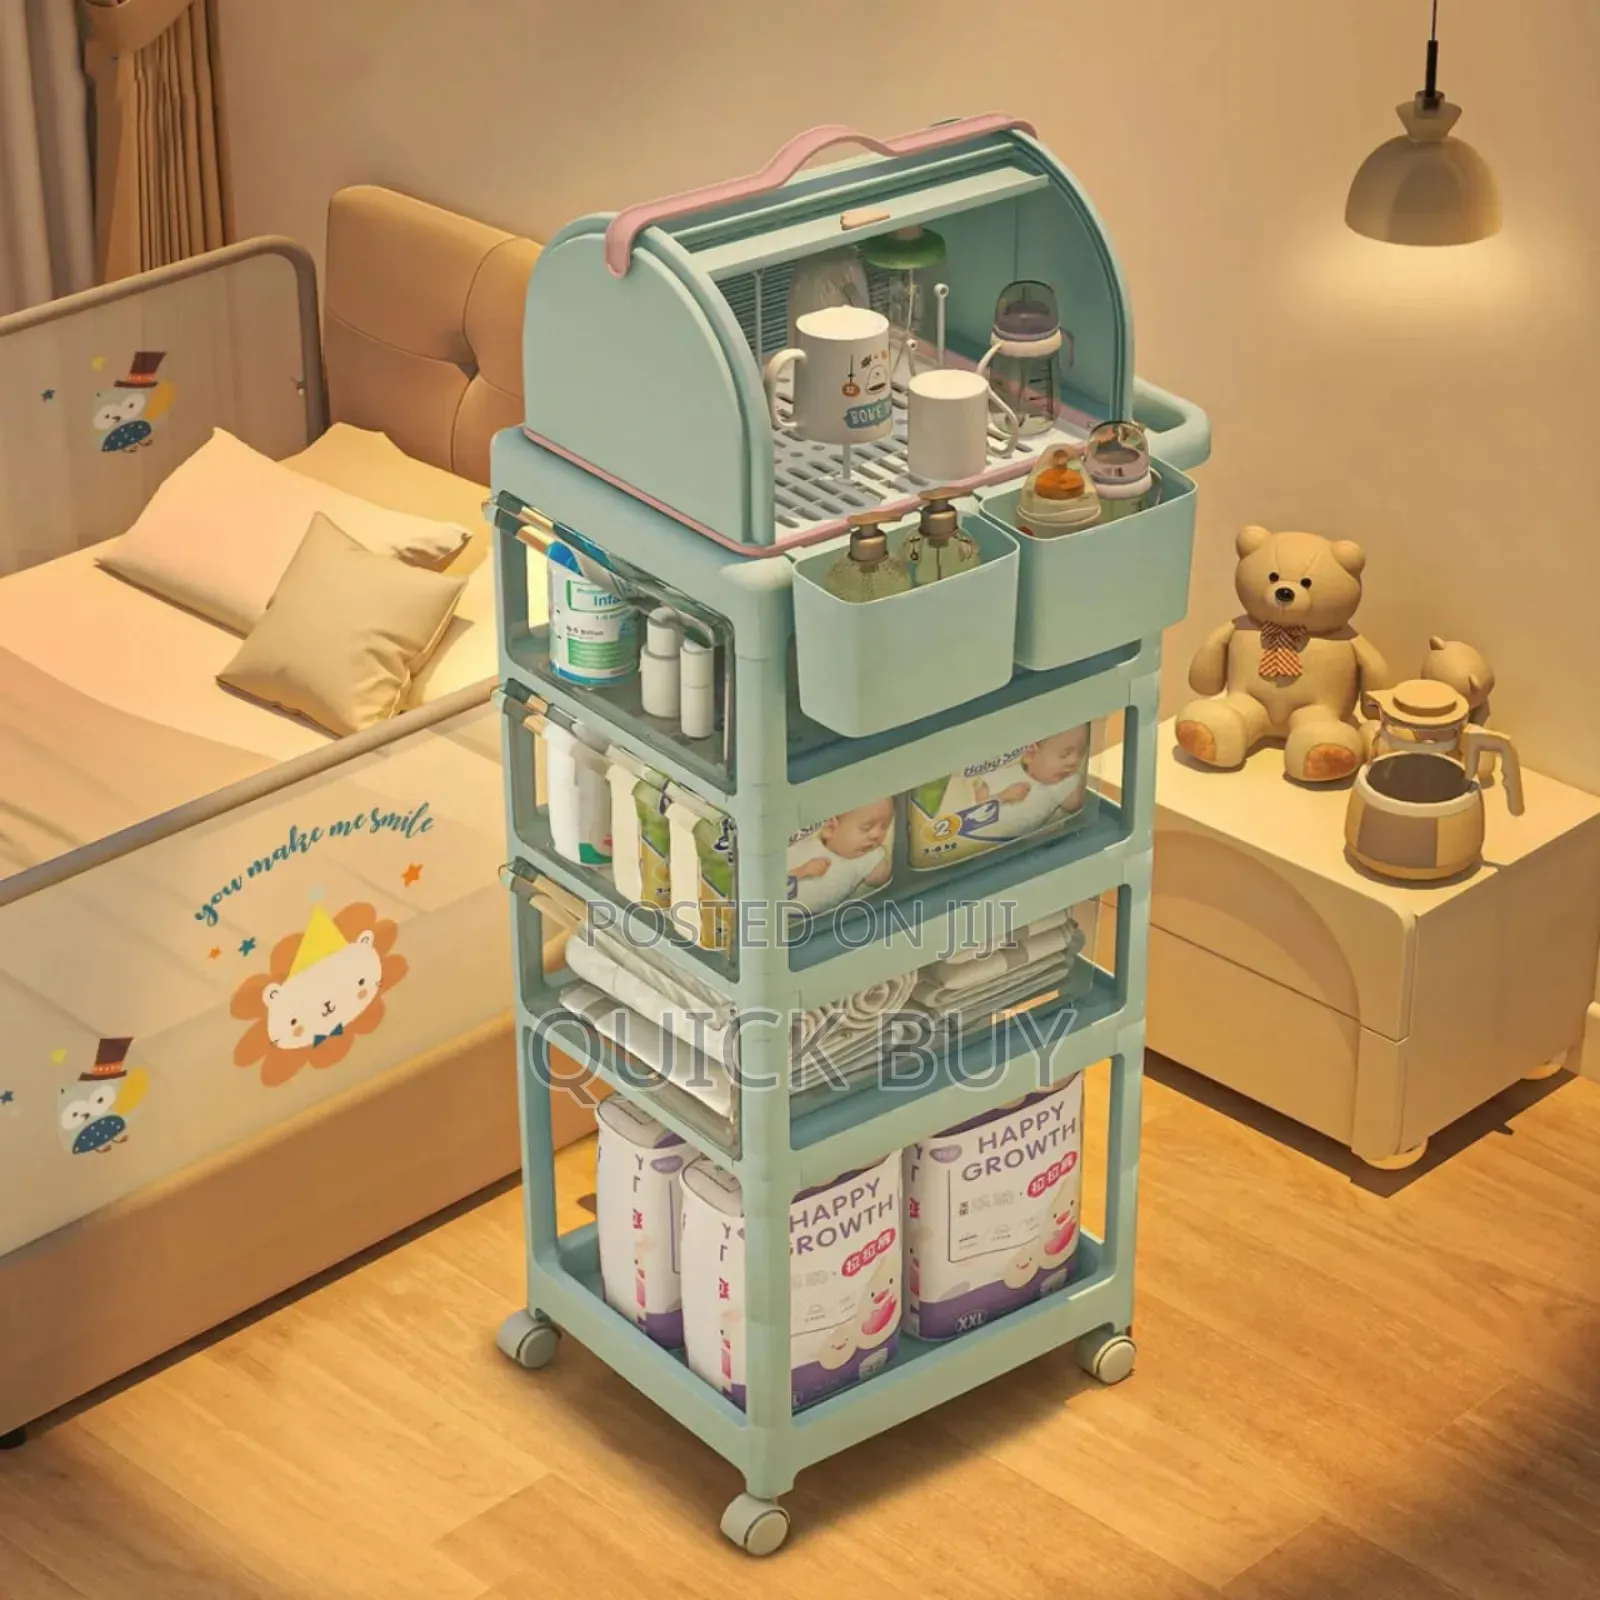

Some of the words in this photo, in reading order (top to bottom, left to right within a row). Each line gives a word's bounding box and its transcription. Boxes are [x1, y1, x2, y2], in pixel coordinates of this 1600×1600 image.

[935, 819, 951, 837] 2
[194, 875, 243, 928] you
[246, 824, 325, 878] make
[328, 812, 368, 837] me
[369, 802, 434, 839] smile
[961, 1117, 1077, 1182] GROWTH
[978, 1100, 1065, 1155] HAPPY
[789, 1177, 880, 1234] HAPPY
[789, 1193, 893, 1256] ROWTH
[956, 1312, 986, 1331] XXL
